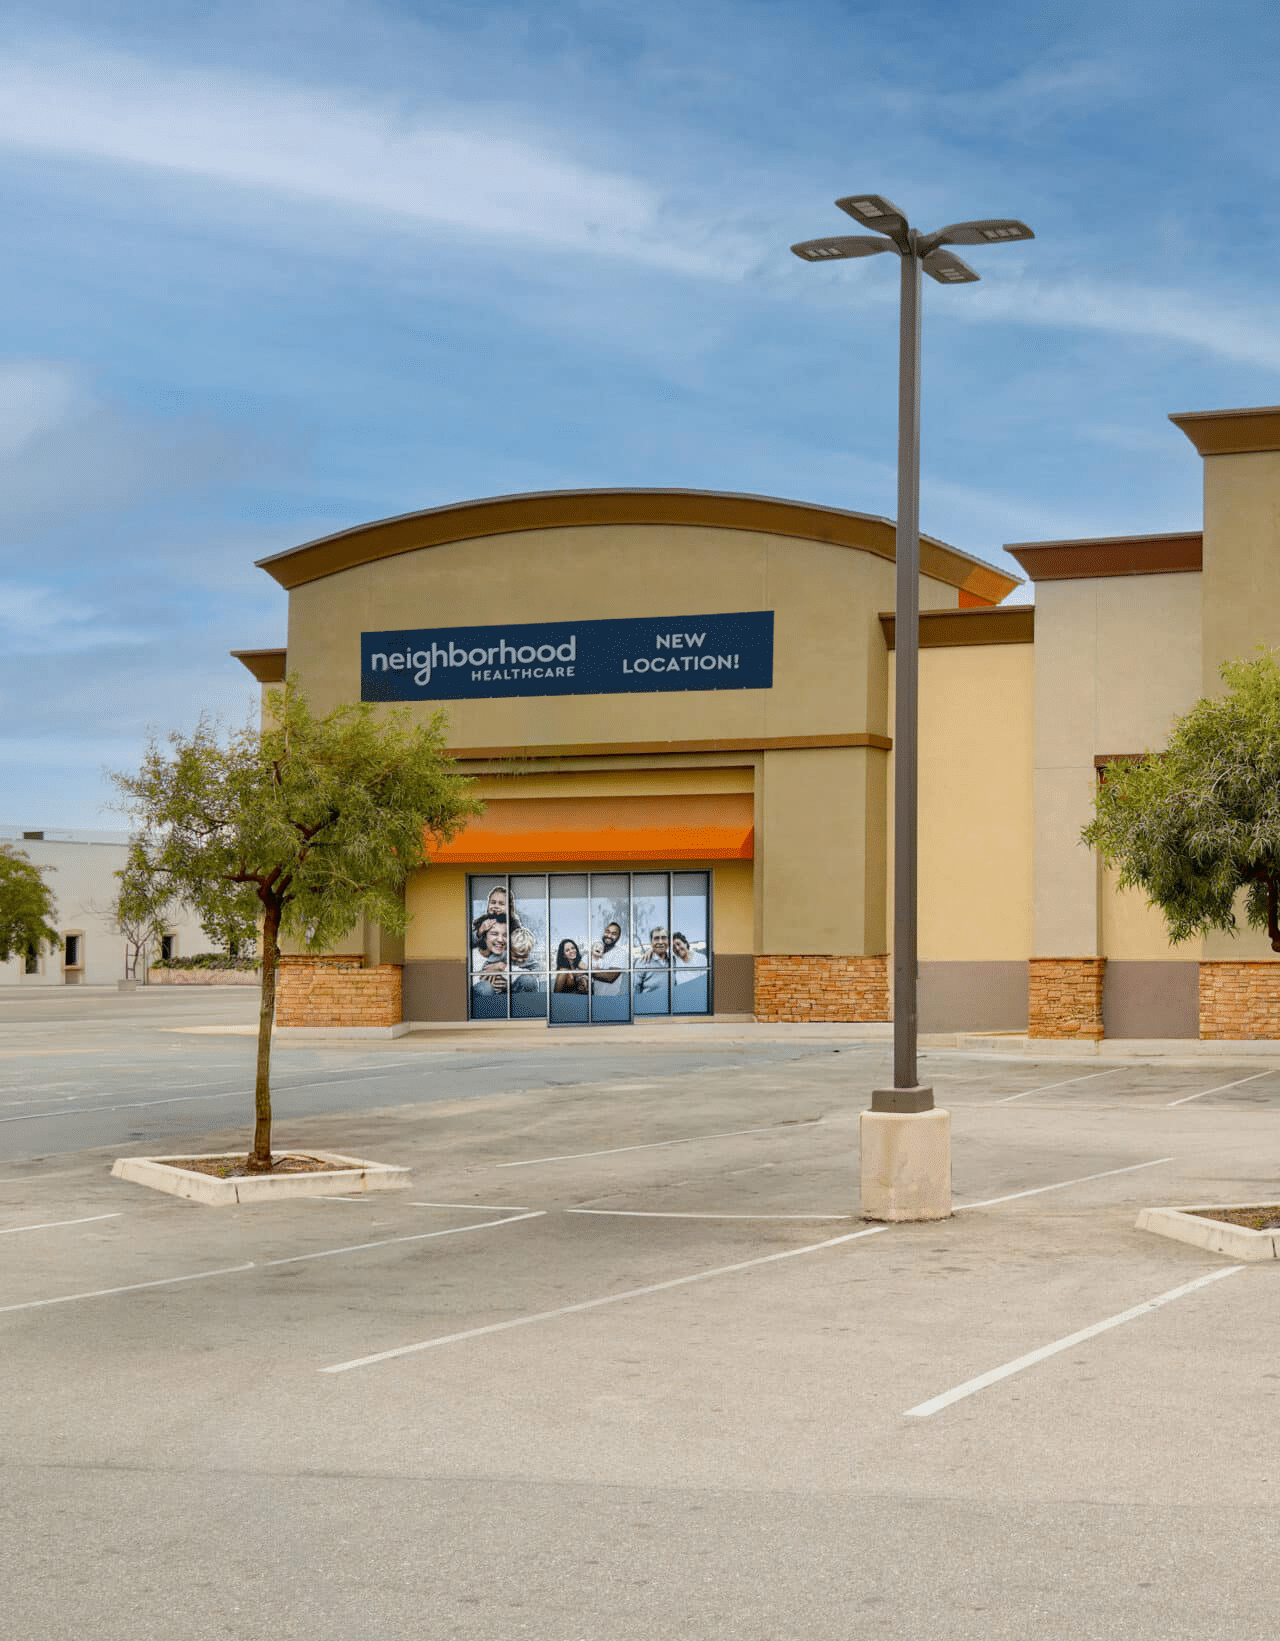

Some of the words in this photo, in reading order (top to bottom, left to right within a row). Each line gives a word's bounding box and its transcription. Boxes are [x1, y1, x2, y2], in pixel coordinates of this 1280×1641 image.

[655, 632, 707, 650] NEW
[371, 635, 577, 686] neighborhood
[622, 653, 740, 674] LOCATION!
[471, 665, 576, 682] HEALTHCARE
